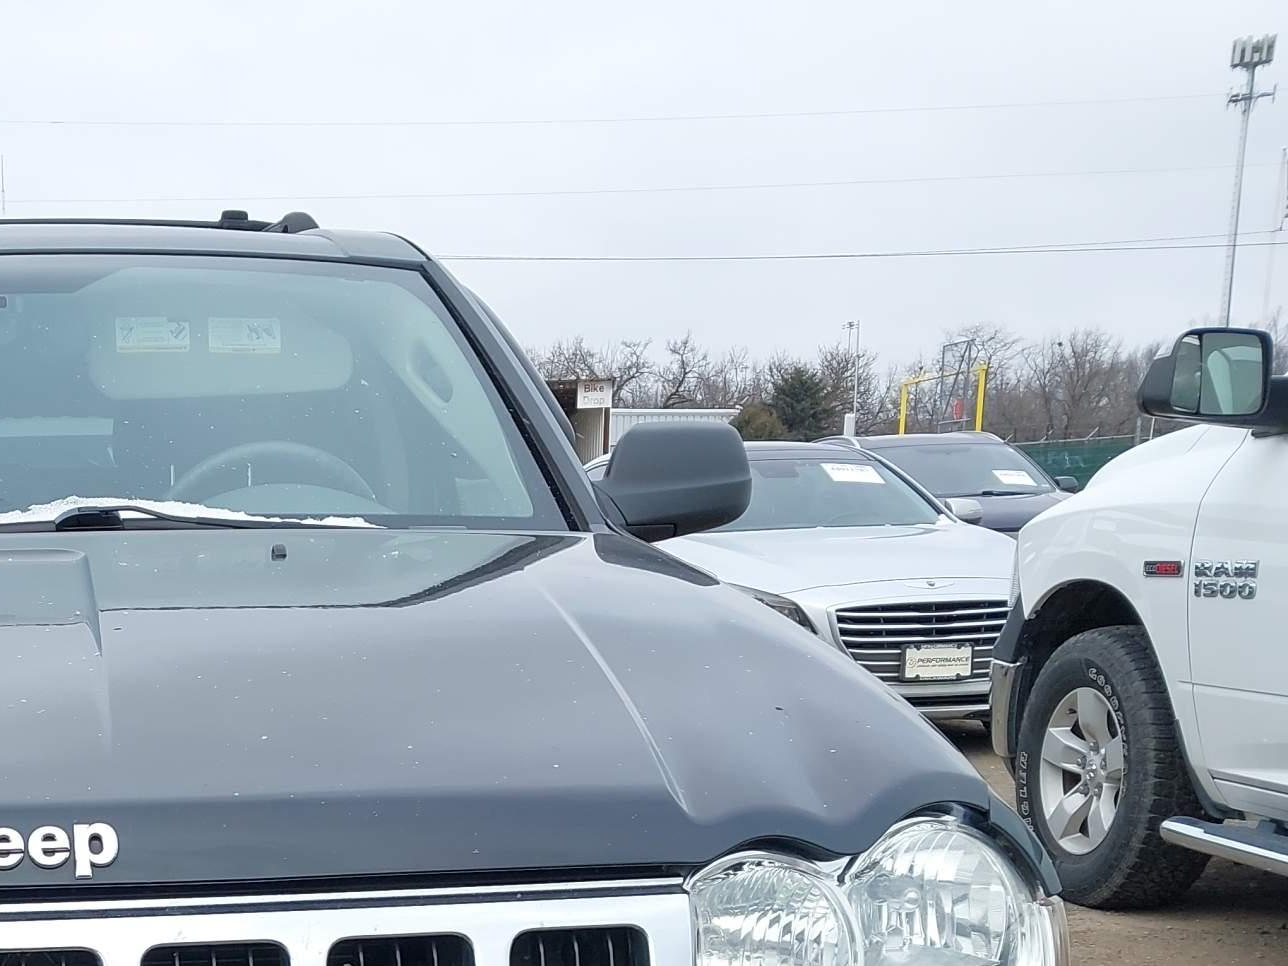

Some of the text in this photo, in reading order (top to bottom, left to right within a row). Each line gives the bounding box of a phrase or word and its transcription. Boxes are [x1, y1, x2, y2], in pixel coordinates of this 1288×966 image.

[583, 383, 605, 393] Bike
[1194, 560, 1258, 579] RAM
[1193, 580, 1257, 600] 1500
[917, 656, 970, 664] PERFORMANCE
